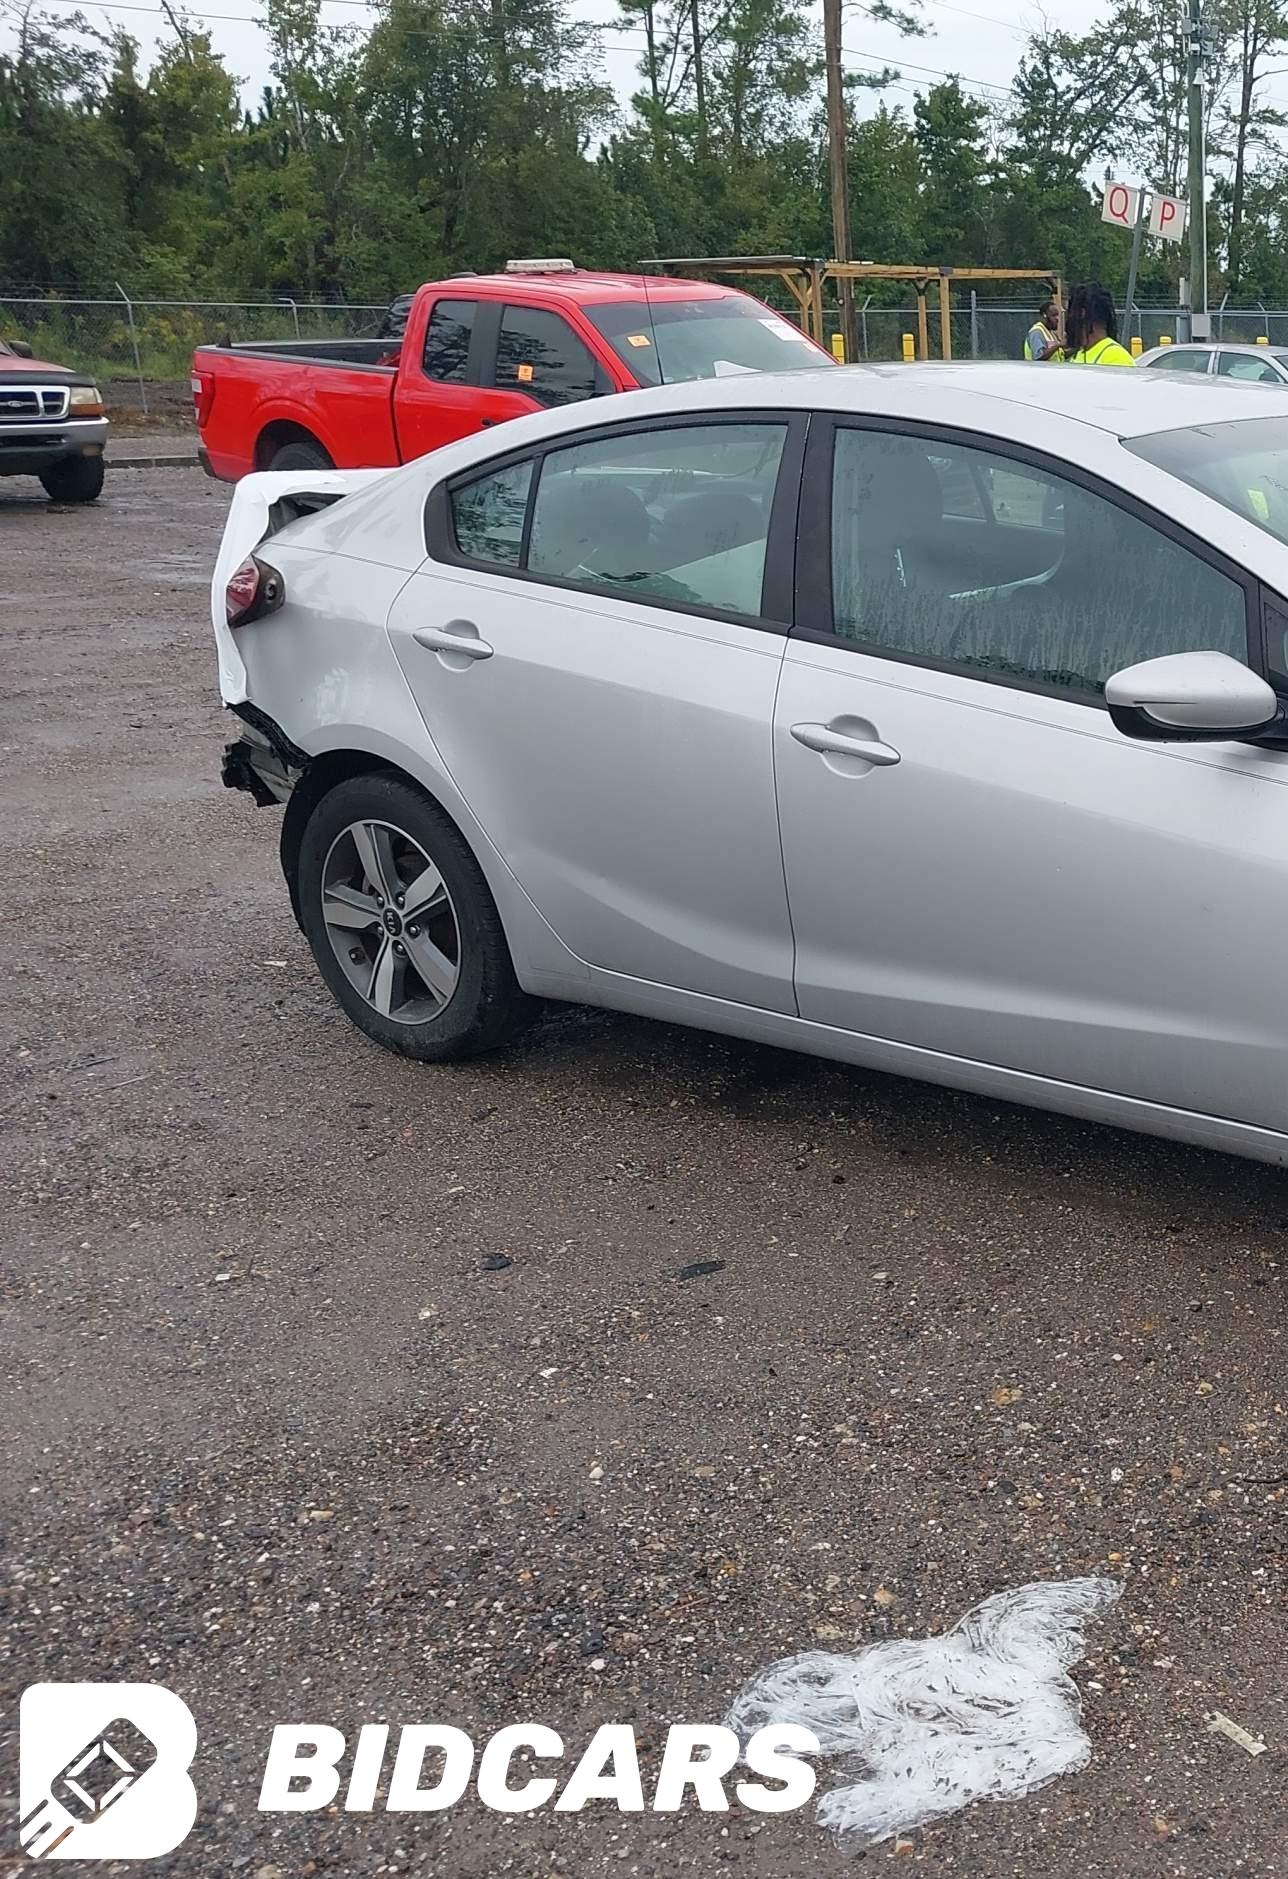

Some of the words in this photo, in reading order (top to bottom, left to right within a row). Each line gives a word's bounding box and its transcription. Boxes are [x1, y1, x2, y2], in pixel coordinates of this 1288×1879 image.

[1109, 186, 1129, 224] Q
[1159, 200, 1176, 231] P
[386, 911, 397, 934] KIA
